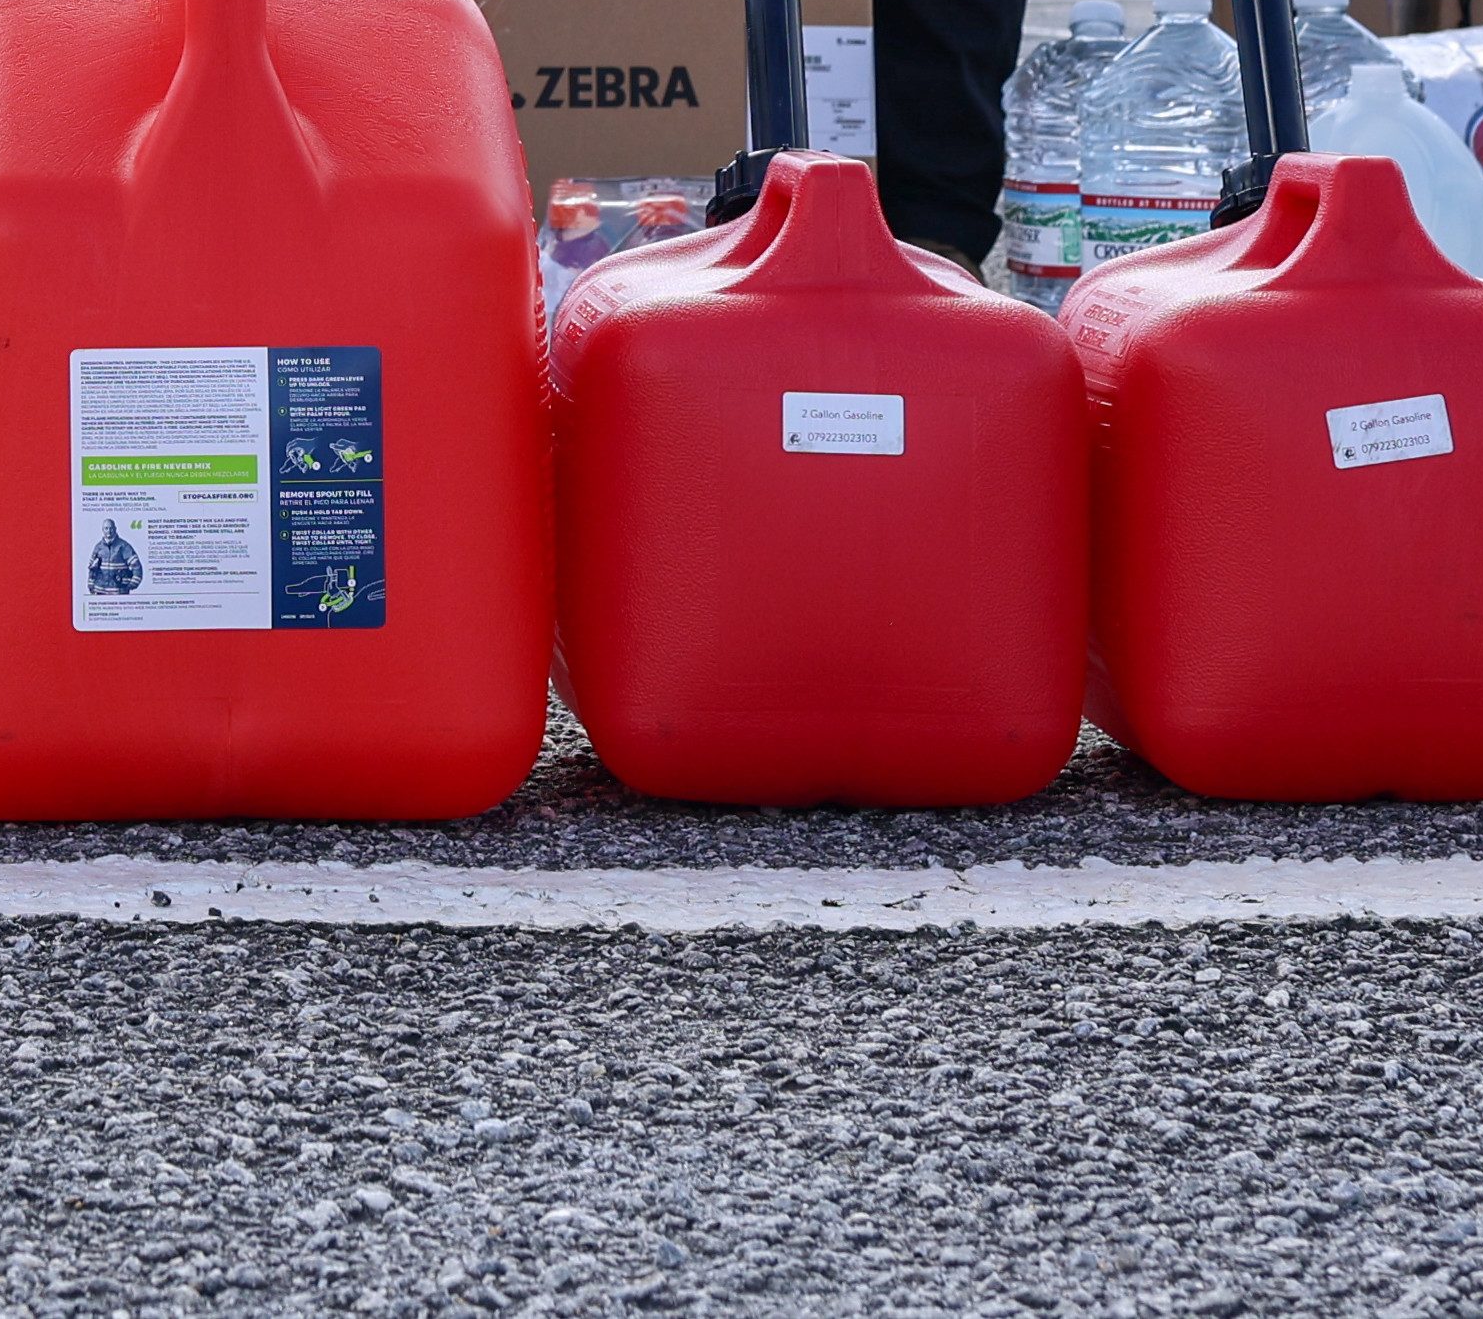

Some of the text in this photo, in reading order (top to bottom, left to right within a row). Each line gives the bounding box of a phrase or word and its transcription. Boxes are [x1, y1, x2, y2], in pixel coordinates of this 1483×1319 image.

[535, 66, 700, 109] ZEBRA
[1154, 199, 1172, 209] THE
[277, 358, 298, 366] HOW
[801, 409, 884, 421] 2 Gallon Gasoline
[1351, 411, 1432, 432] 2 Gallon Gasoline
[807, 432, 878, 444] 079223023103
[1361, 434, 1431, 455] 079223023103
[88, 463, 132, 471] GASOLINE
[141, 463, 162, 471] FIRE
[163, 463, 193, 471] NEVER
[194, 462, 211, 470] MIX
[279, 491, 315, 499] REMOVE
[344, 490, 355, 498] TO
[356, 489, 372, 497] FILL
